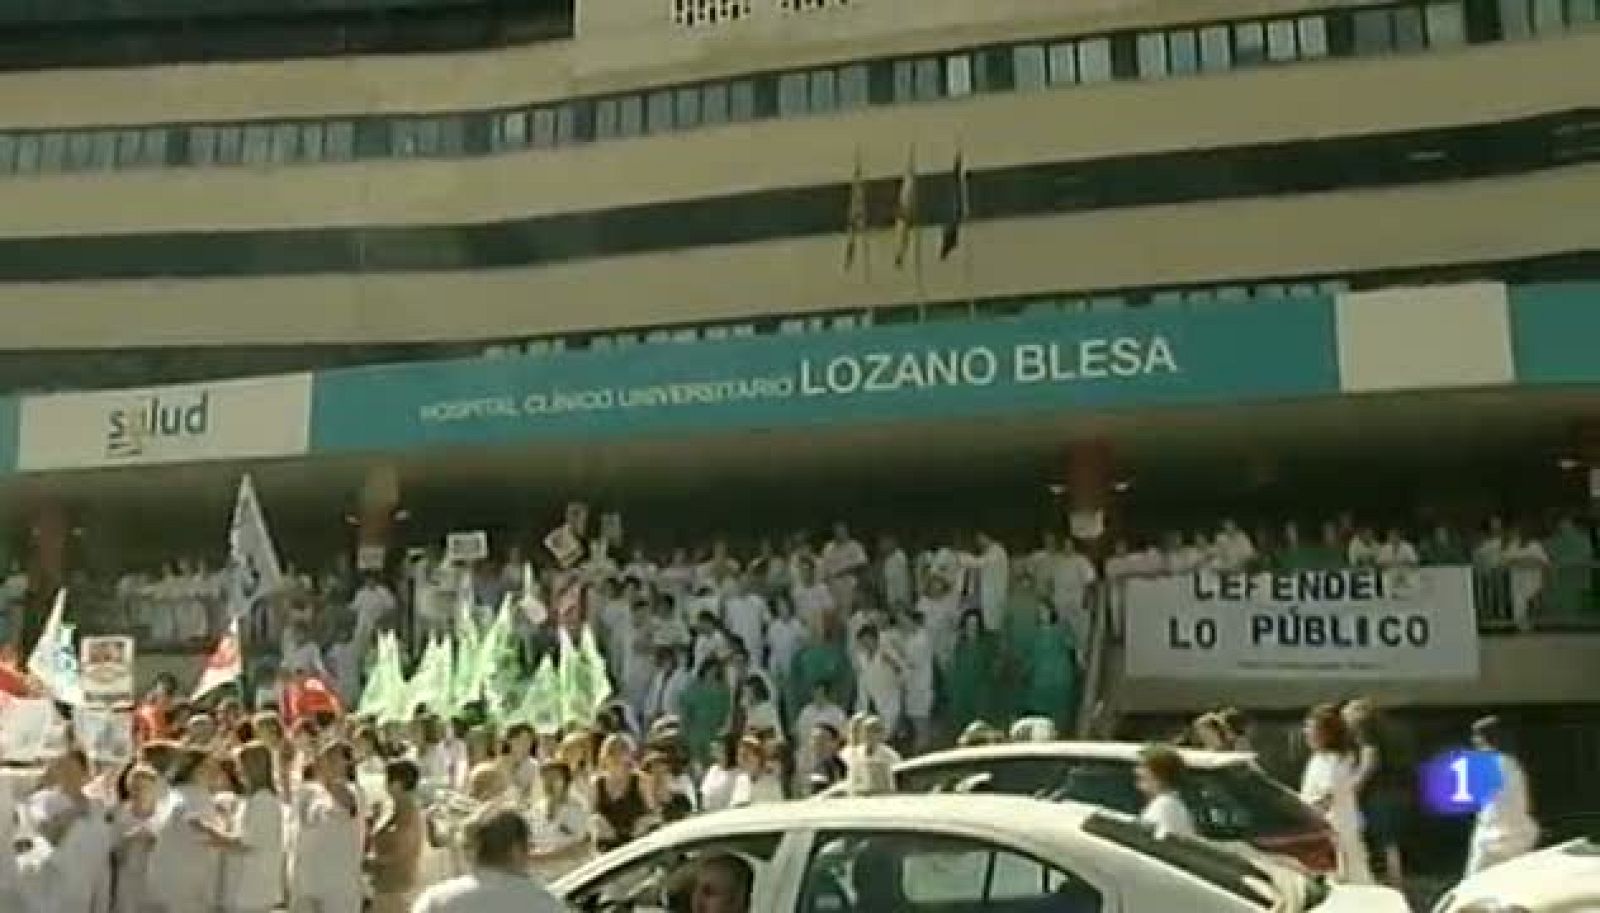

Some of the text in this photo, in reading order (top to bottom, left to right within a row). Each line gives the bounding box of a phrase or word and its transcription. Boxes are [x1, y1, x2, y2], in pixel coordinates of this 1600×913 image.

[801, 345, 997, 395] LOZANO
[1014, 335, 1178, 382] BLESA
[107, 388, 209, 437] salud
[1169, 606, 1430, 649] LO PÚBLICO
